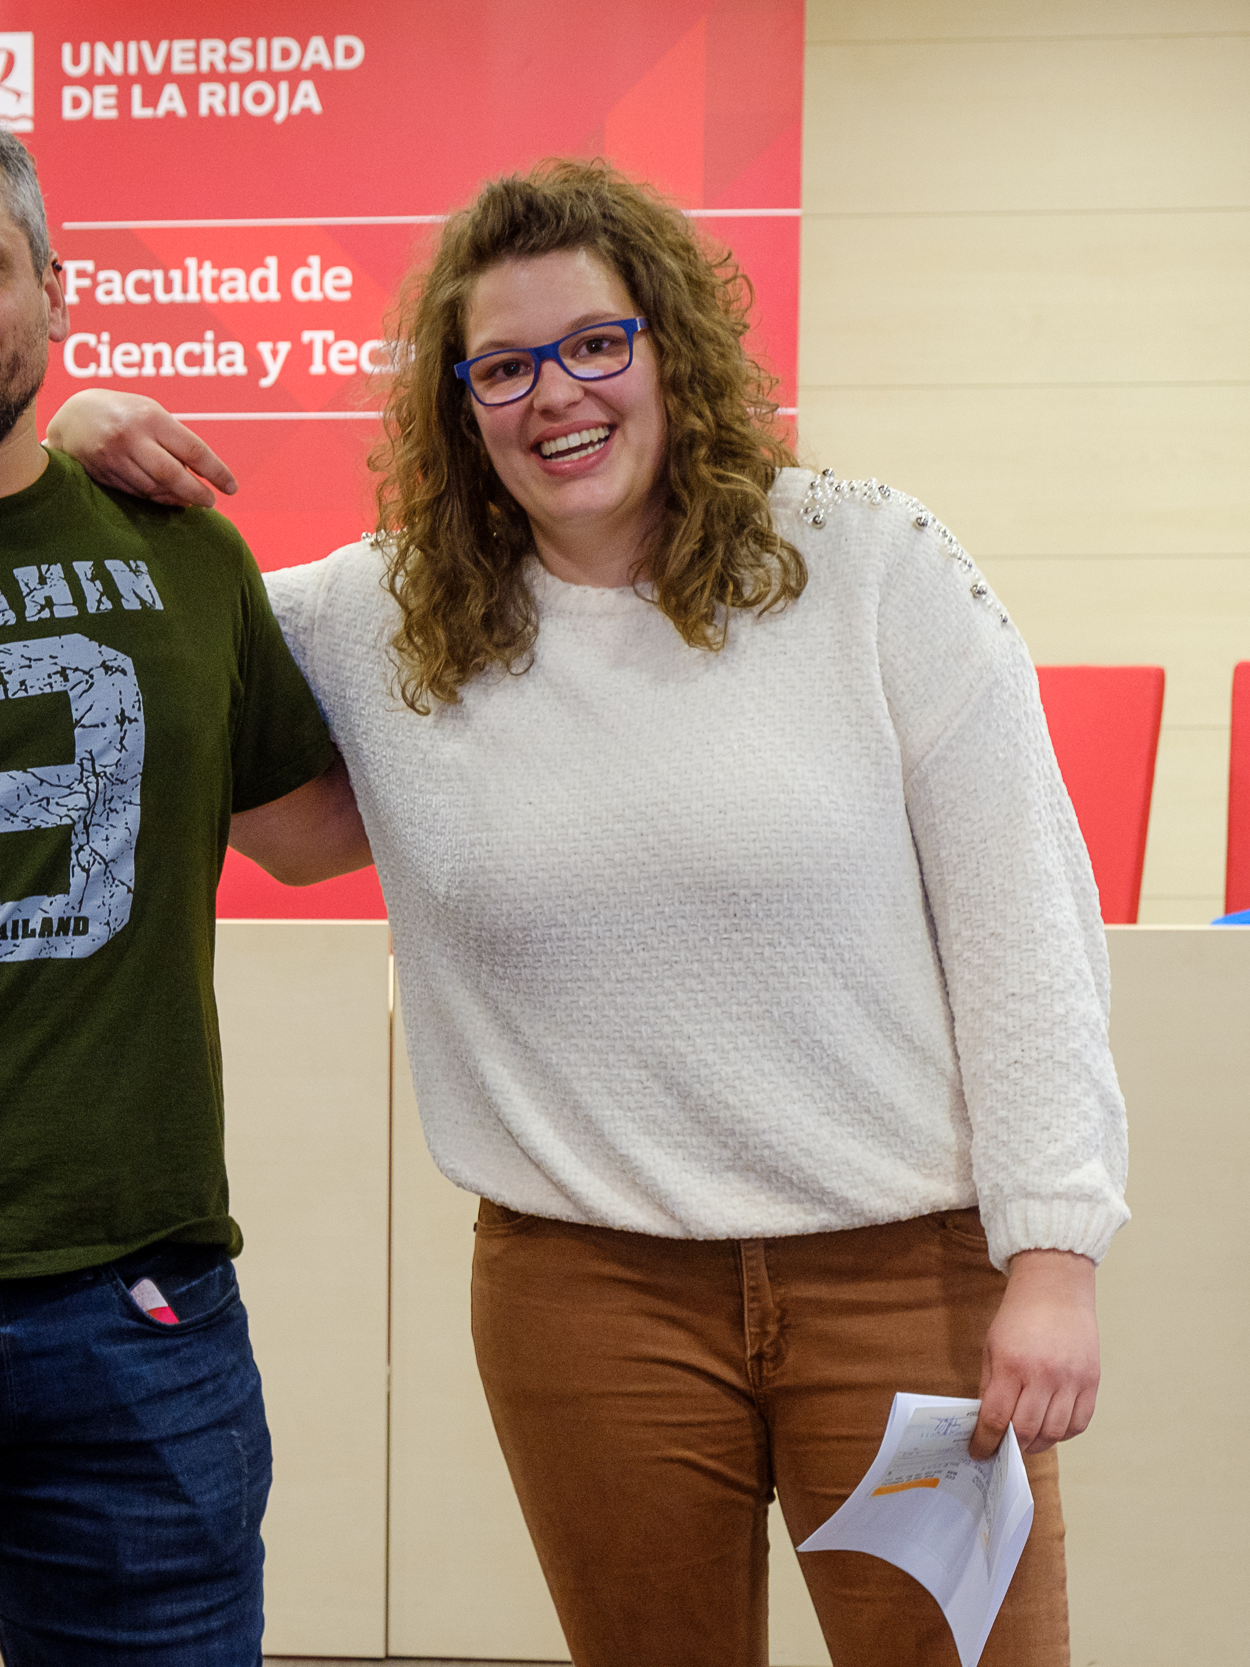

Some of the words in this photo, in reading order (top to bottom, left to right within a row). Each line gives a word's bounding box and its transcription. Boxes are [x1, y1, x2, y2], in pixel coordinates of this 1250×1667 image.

[61, 35, 366, 77] UNIVERSIDAD
[61, 84, 119, 120] DE
[130, 83, 187, 119] LA
[198, 80, 323, 124] RIOJA
[63, 256, 281, 304] Facultad
[291, 255, 353, 302] de
[63, 331, 247, 378] Ciencia
[256, 341, 291, 388] y
